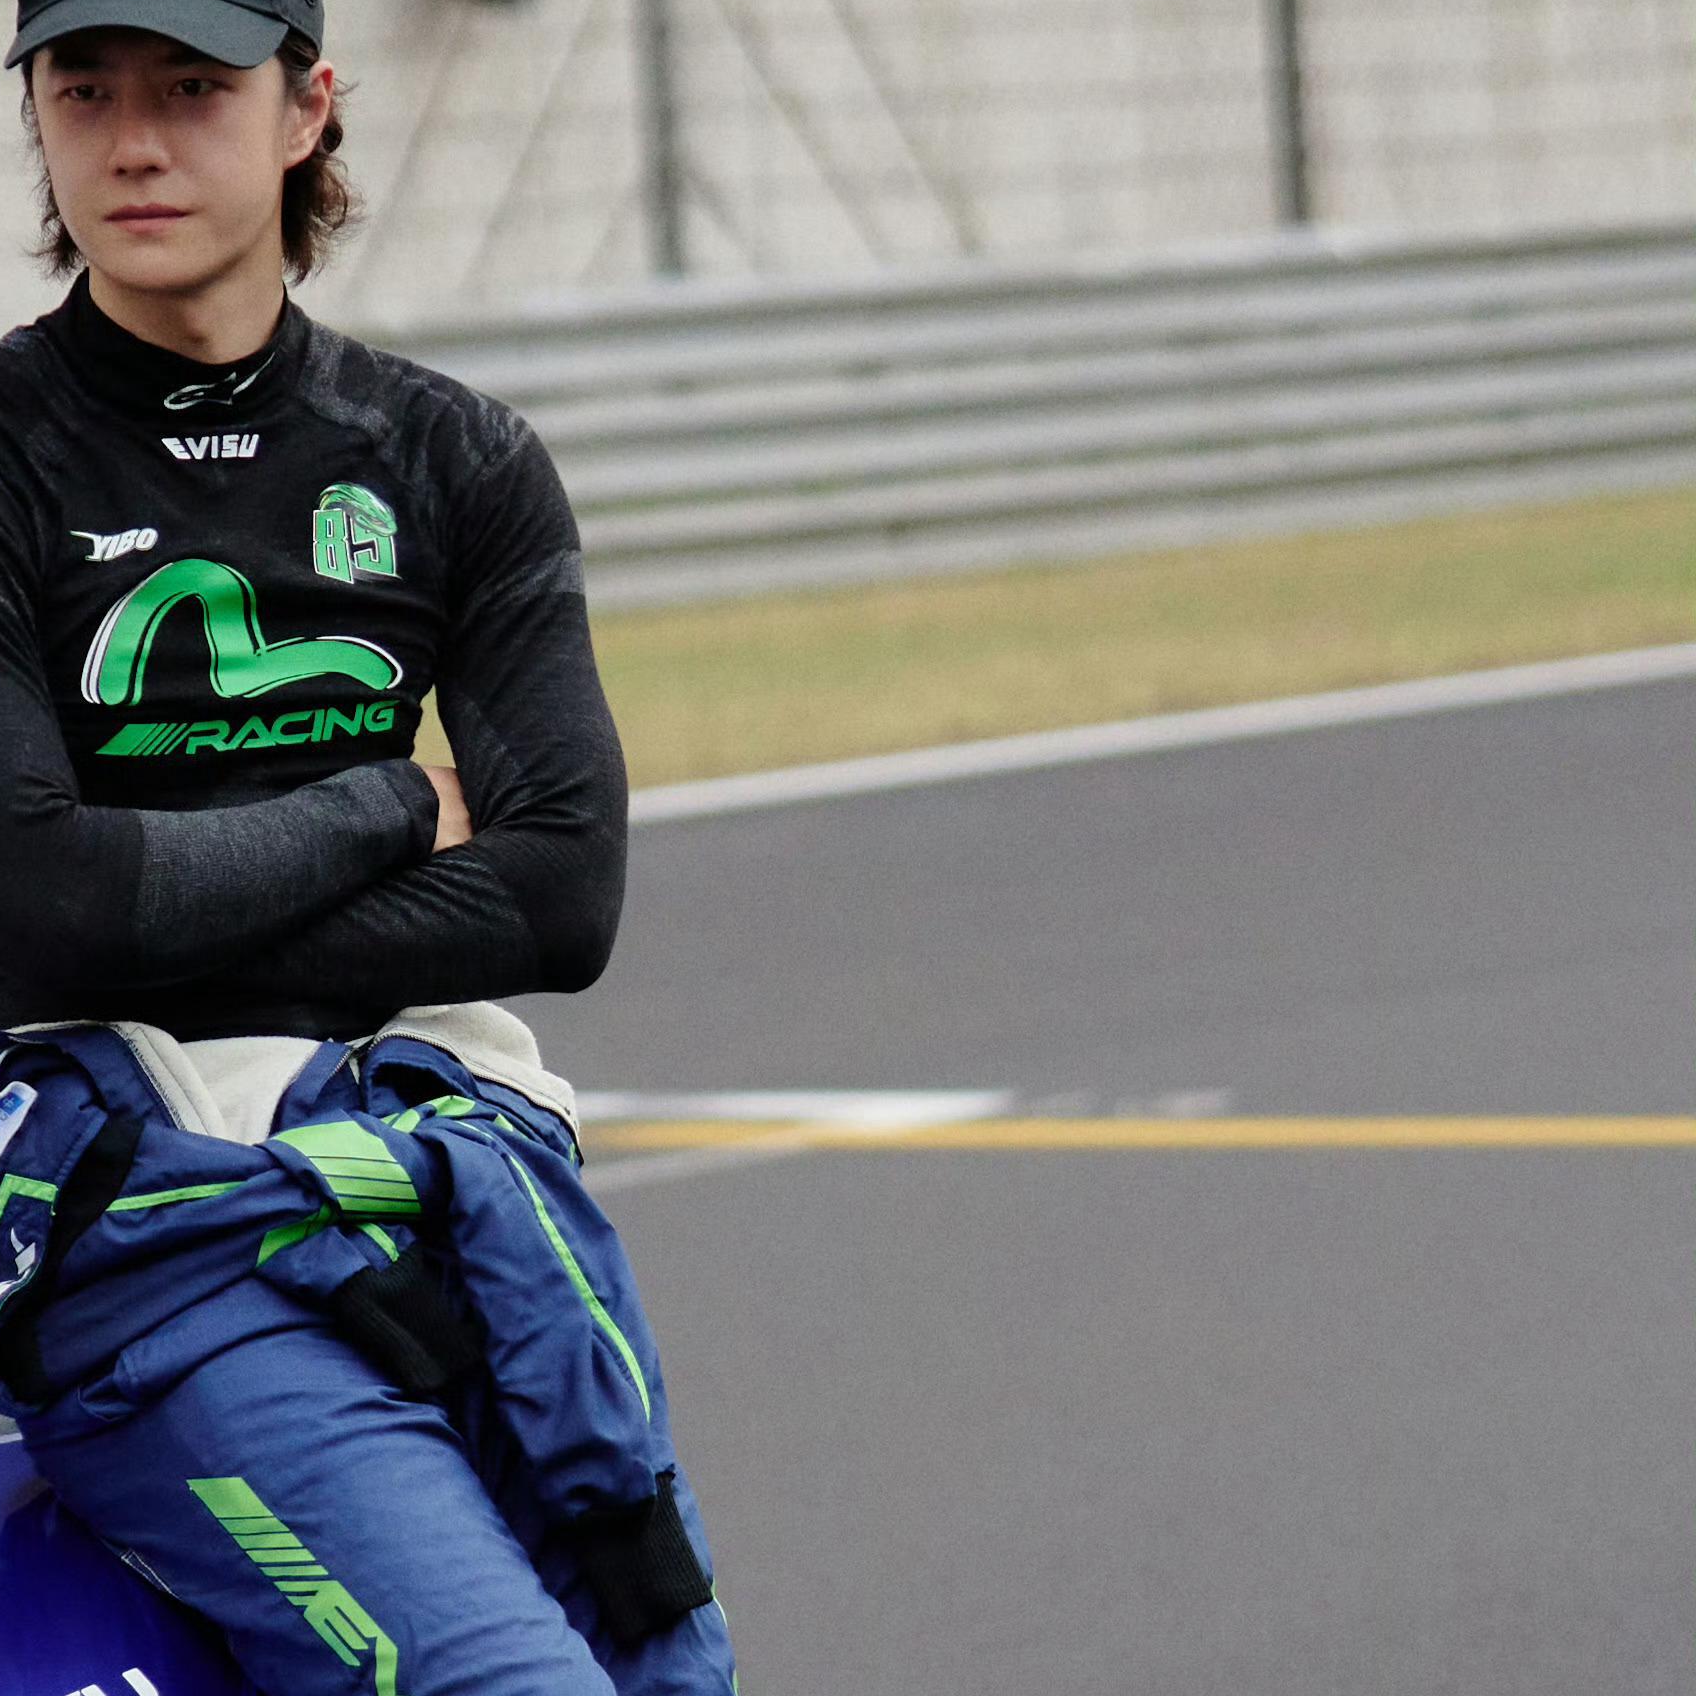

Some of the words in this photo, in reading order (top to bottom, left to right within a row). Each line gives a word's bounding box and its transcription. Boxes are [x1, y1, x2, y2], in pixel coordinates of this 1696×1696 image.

[161, 434, 260, 460] EVISU
[70, 527, 159, 562] YIBO
[185, 700, 401, 755] RACING
